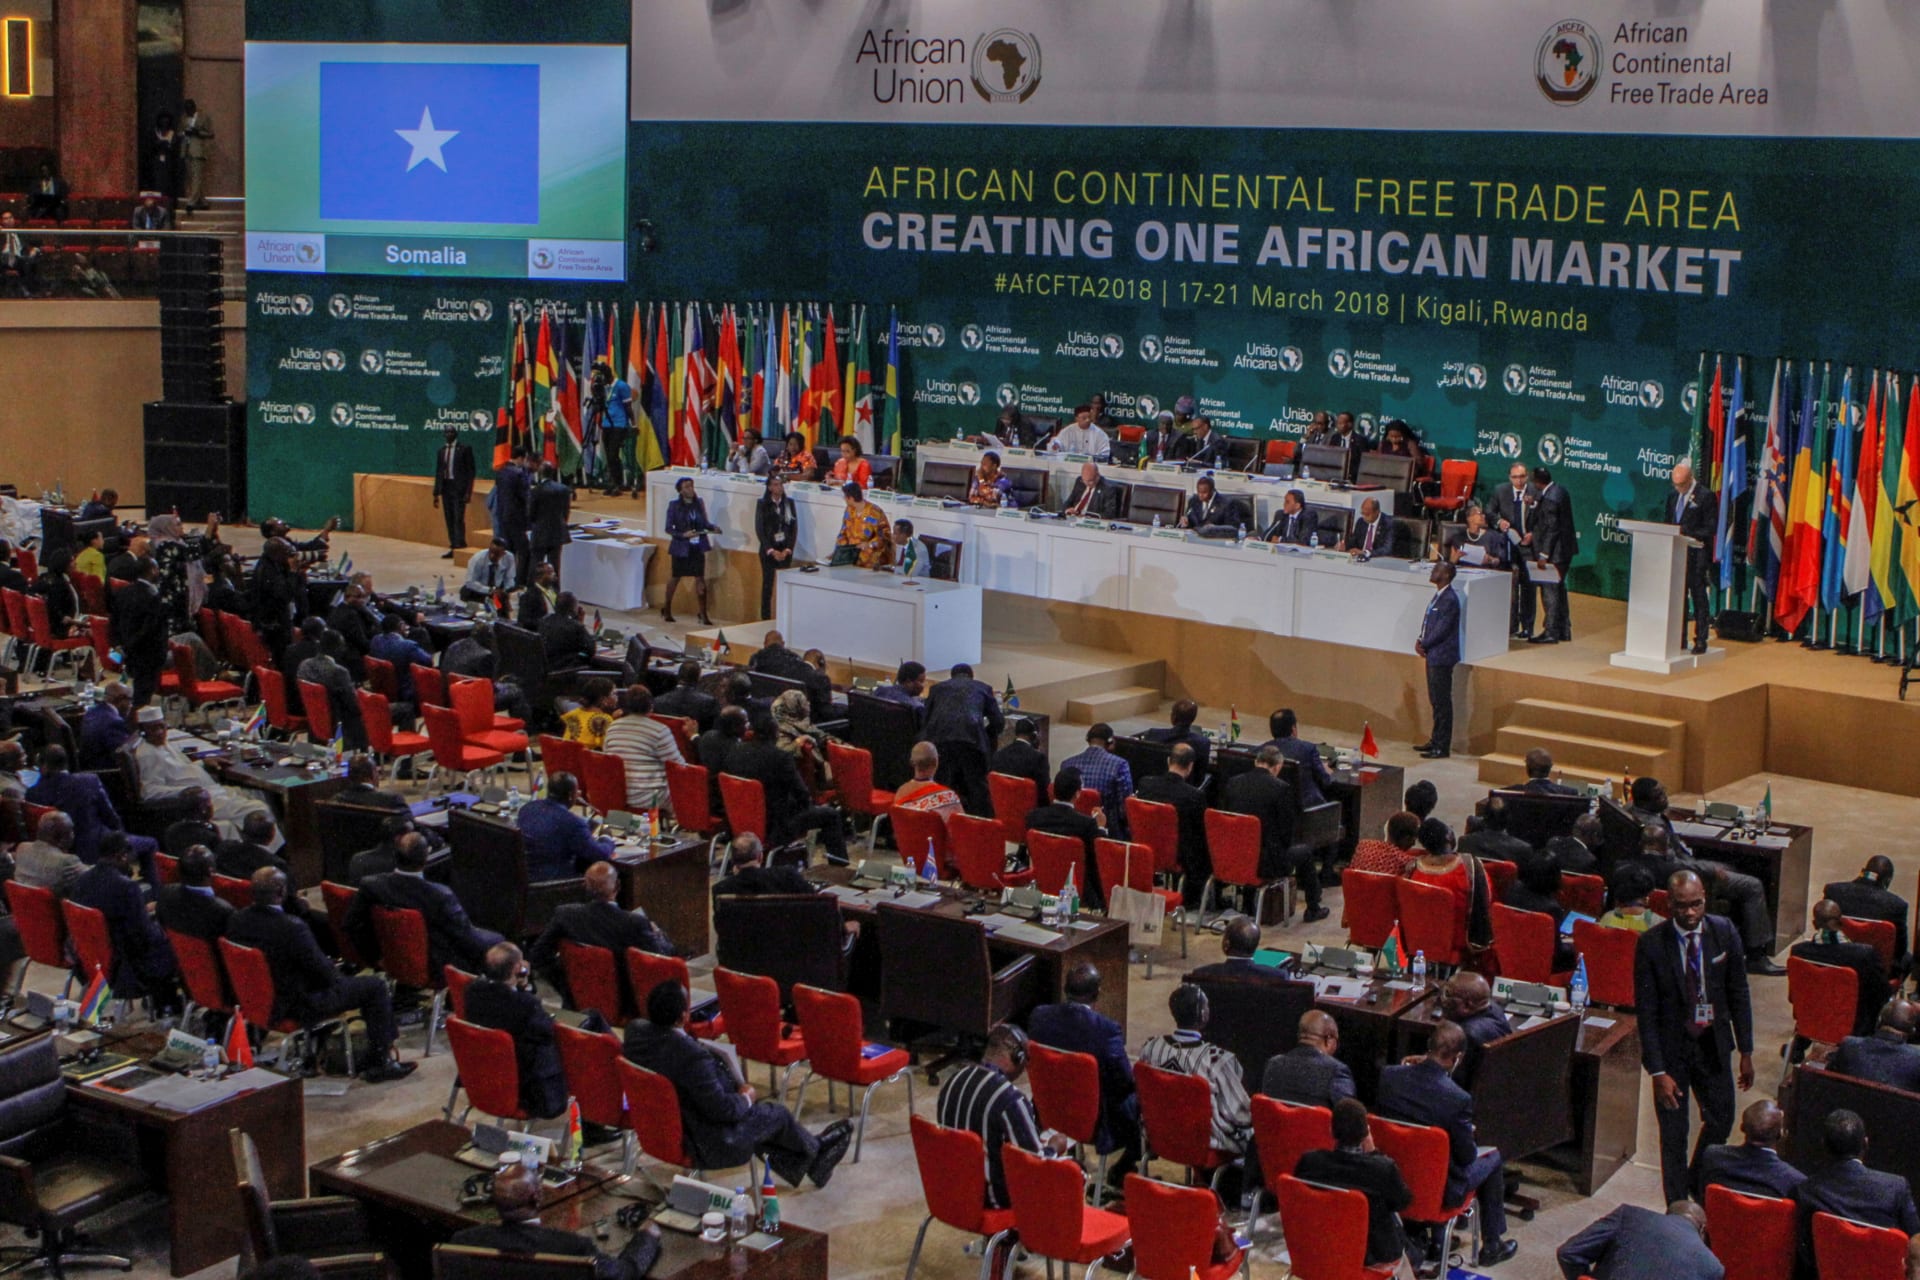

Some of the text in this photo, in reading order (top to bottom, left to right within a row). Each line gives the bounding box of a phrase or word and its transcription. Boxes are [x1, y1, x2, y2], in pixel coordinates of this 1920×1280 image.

[1614, 23, 1687, 43] African
[856, 29, 965, 64] African
[1612, 52, 1731, 73] Continental
[874, 68, 964, 103] Union
[1611, 83, 1768, 105] Free Trade Area
[864, 167, 1741, 231] AFRICAN CONTINENTAL FREE TRADE AREA
[263, 253, 295, 263] Union
[386, 245, 466, 265] Somalia
[862, 212, 1742, 296] CREATING ONE AFRICAN MARKET
[256, 292, 290, 304] African
[995, 273, 1151, 301] #AfCFTA2018
[1180, 282, 1238, 305] 17-21
[1252, 285, 1322, 310] March
[1335, 291, 1389, 315] 2018
[261, 304, 290, 315] Union
[437, 298, 468, 309] Union
[423, 309, 468, 321] Africaine
[1068, 331, 1098, 344] União
[290, 347, 321, 359] União
[1056, 343, 1098, 358] Africana
[1247, 342, 1278, 357] União
[1354, 350, 1380, 360] African
[279, 358, 321, 371] Africana
[1234, 355, 1278, 371] Africana
[1353, 360, 1396, 371] Continental
[1353, 370, 1410, 384] Free Trade Area
[1529, 366, 1556, 376] African
[926, 378, 957, 392] Union
[1529, 377, 1572, 389] Continental
[1601, 375, 1638, 392] African
[912, 390, 957, 405] Africaine
[1104, 391, 1135, 405] União
[1529, 387, 1586, 402] Free Trade Area
[1606, 390, 1638, 406] Union
[259, 401, 292, 413] African
[438, 408, 469, 419] Union
[1282, 406, 1314, 422] União
[264, 412, 292, 424] Union
[1564, 436, 1592, 447] African
[1564, 447, 1608, 460] Continental
[1637, 448, 1675, 464] African
[1564, 459, 1621, 474] Free Trade Area
